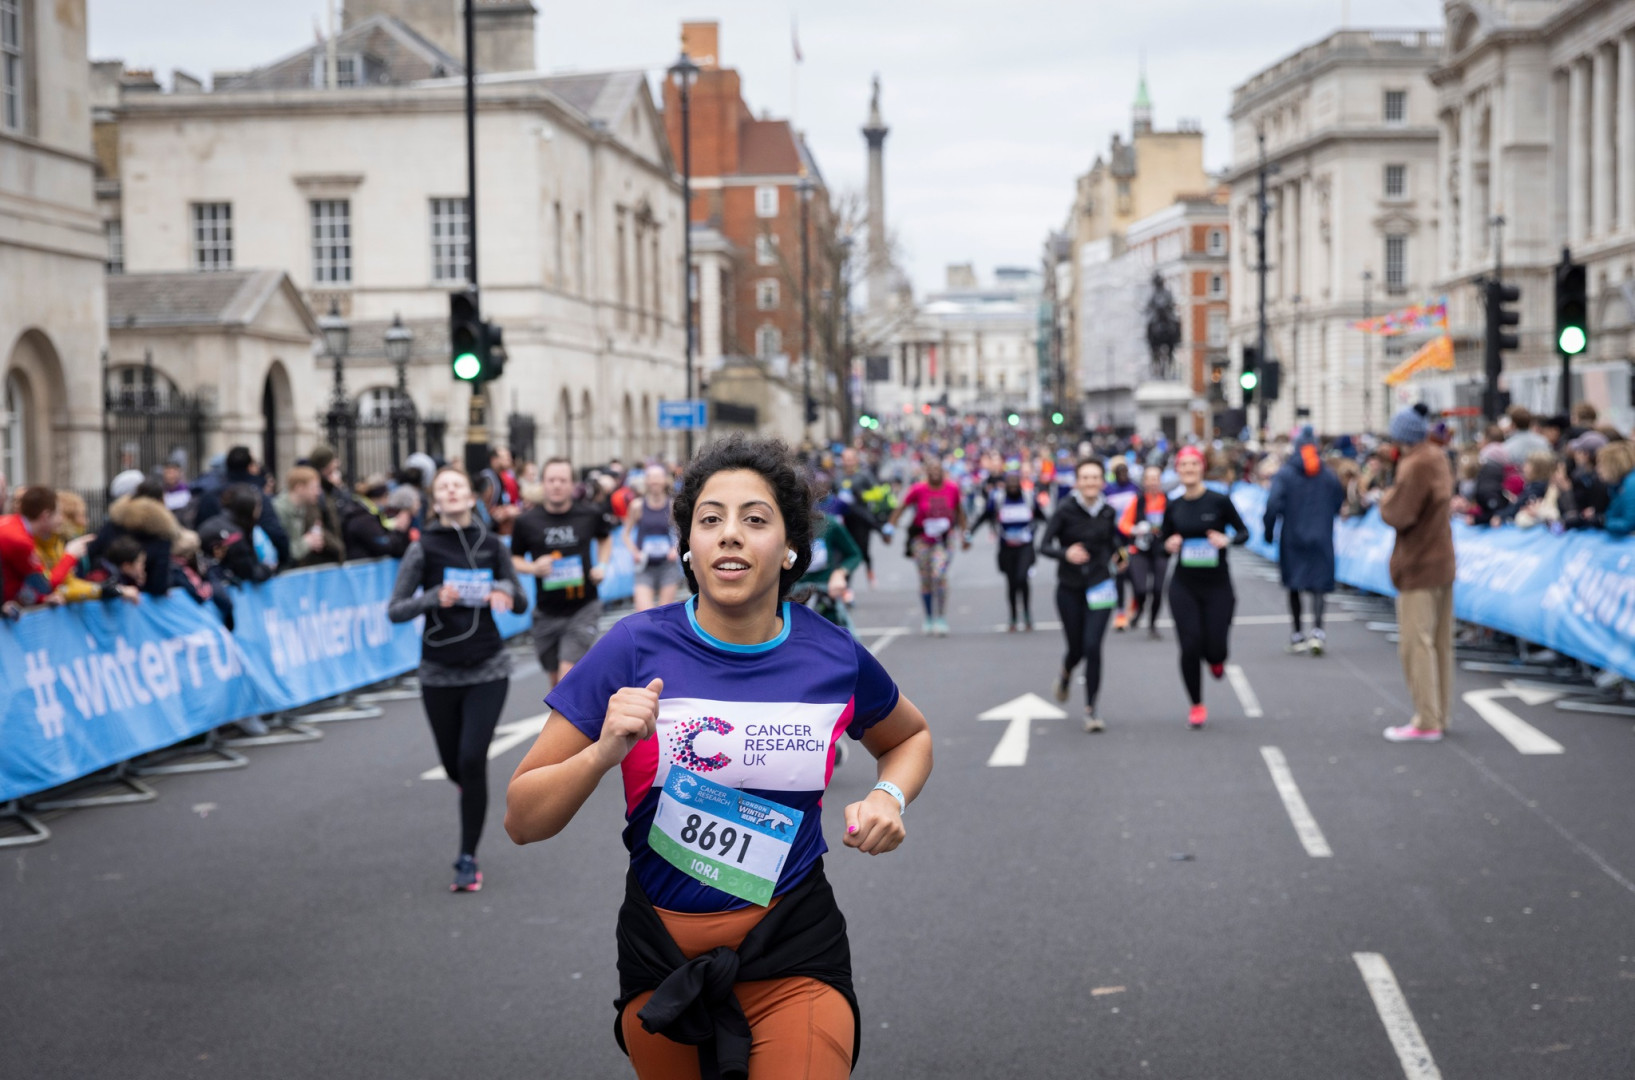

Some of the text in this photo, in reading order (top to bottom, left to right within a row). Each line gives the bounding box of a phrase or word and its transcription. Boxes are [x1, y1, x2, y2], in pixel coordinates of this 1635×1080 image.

[745, 724, 812, 737] CANCER
[744, 738, 825, 752] RESEARCH
[743, 753, 767, 766] UK
[697, 790, 731, 806] RESEARCH
[700, 784, 727, 798] CANCER
[694, 796, 704, 805] UK
[741, 799, 768, 813] LONDON
[739, 805, 766, 820] WINTER
[741, 813, 758, 823] RUN
[680, 813, 752, 864] 8691
[690, 858, 720, 881] IQRA
